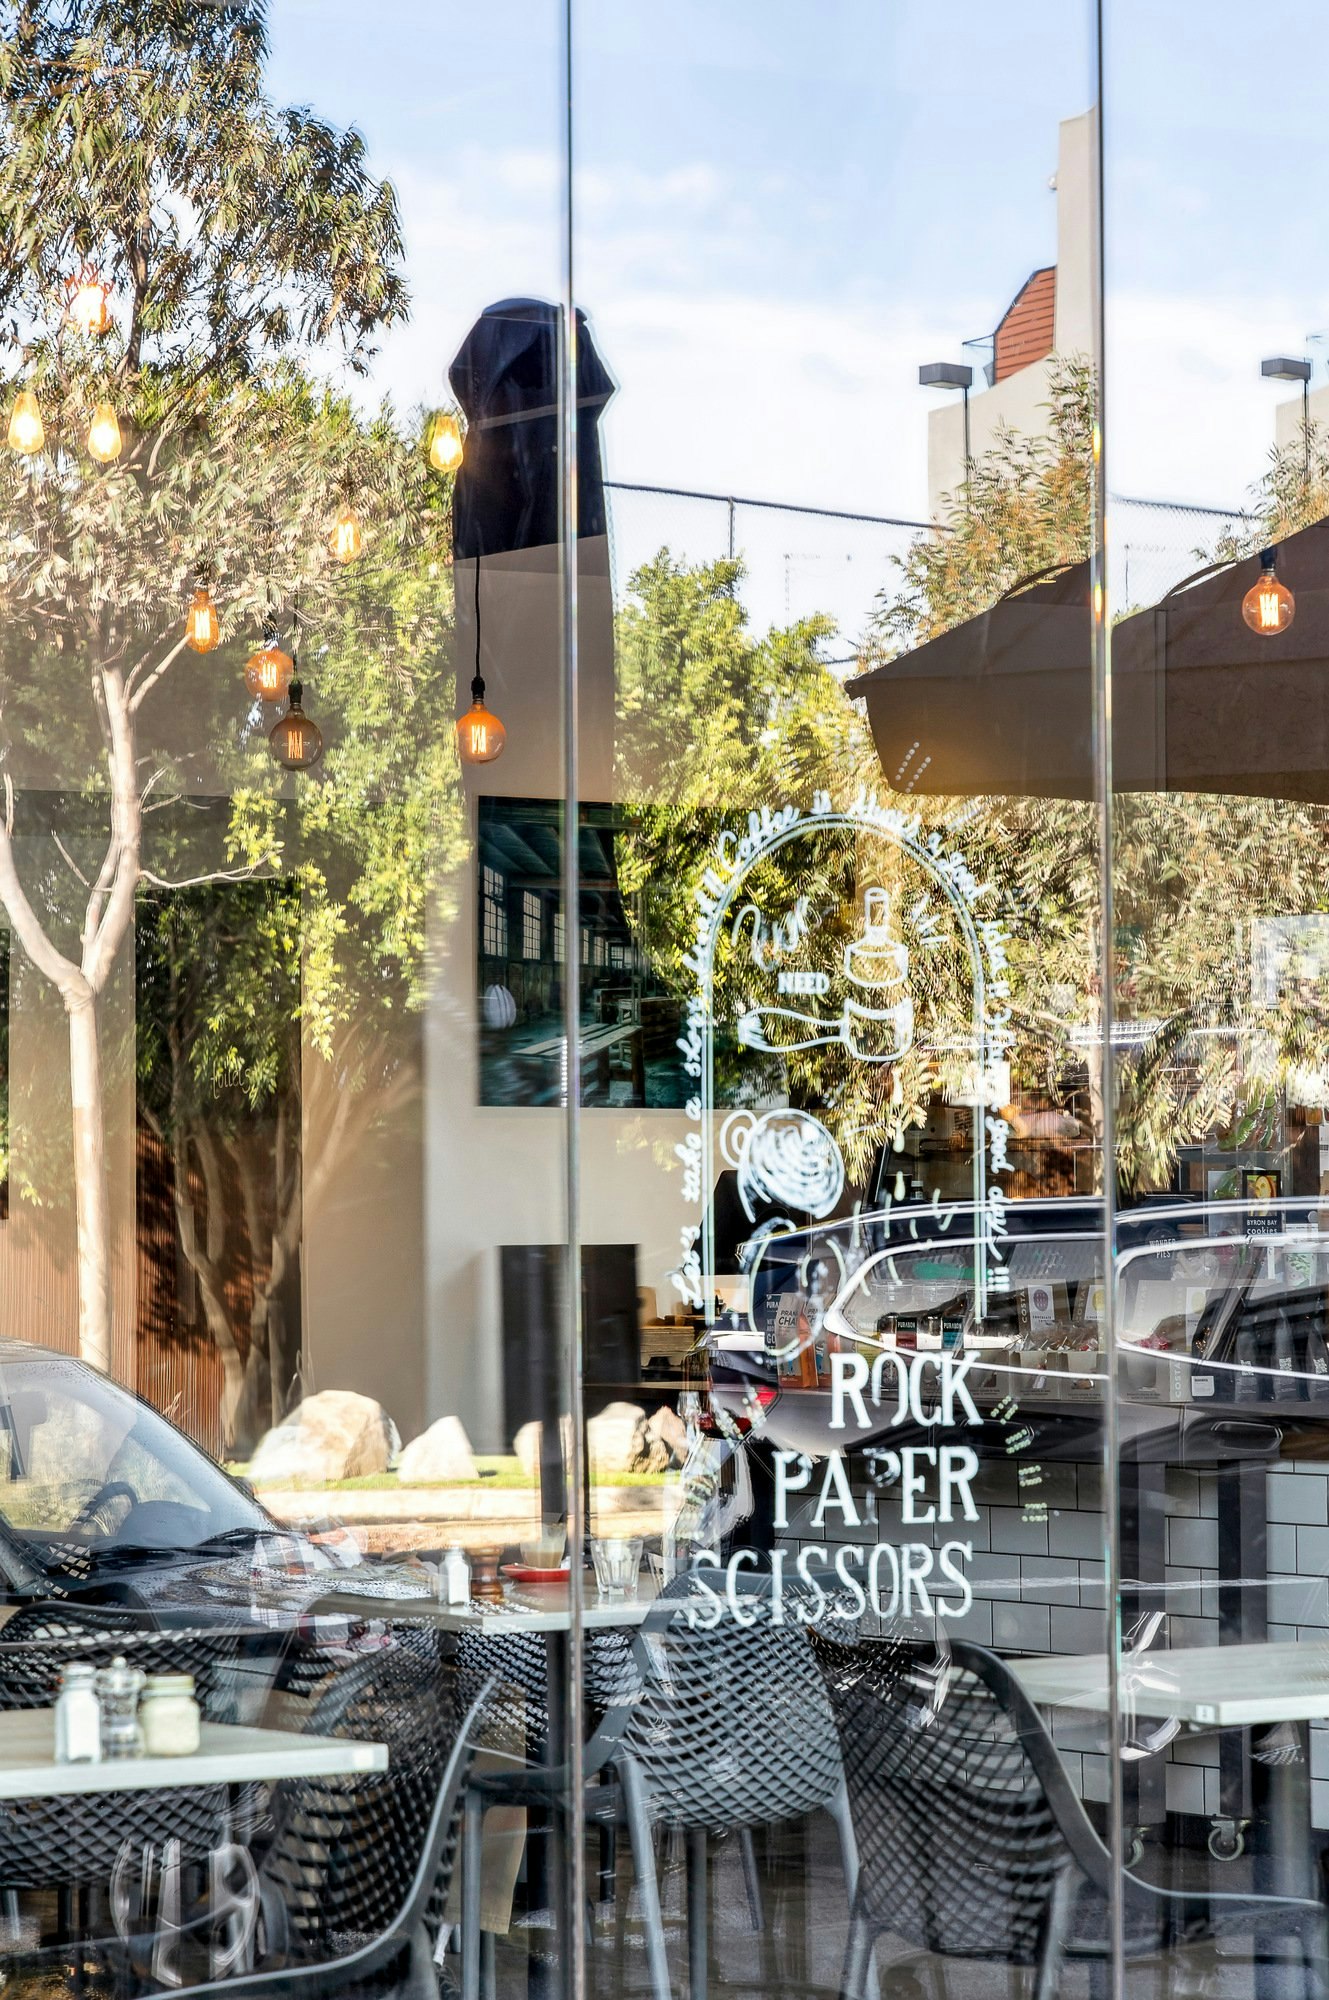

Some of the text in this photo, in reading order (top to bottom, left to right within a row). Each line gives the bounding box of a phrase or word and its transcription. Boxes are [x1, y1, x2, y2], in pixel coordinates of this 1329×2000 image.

[777, 971, 830, 995] NEED
[684, 1096, 702, 1121] a
[674, 1132, 702, 1203] take
[985, 1115, 1016, 1175] good
[1246, 1226, 1278, 1235] cookies
[1020, 1290, 1028, 1324] COSTA
[829, 1350, 984, 1429] ROCK
[772, 1445, 981, 1529] PAPER
[687, 1540, 974, 1630] SCISSORS
